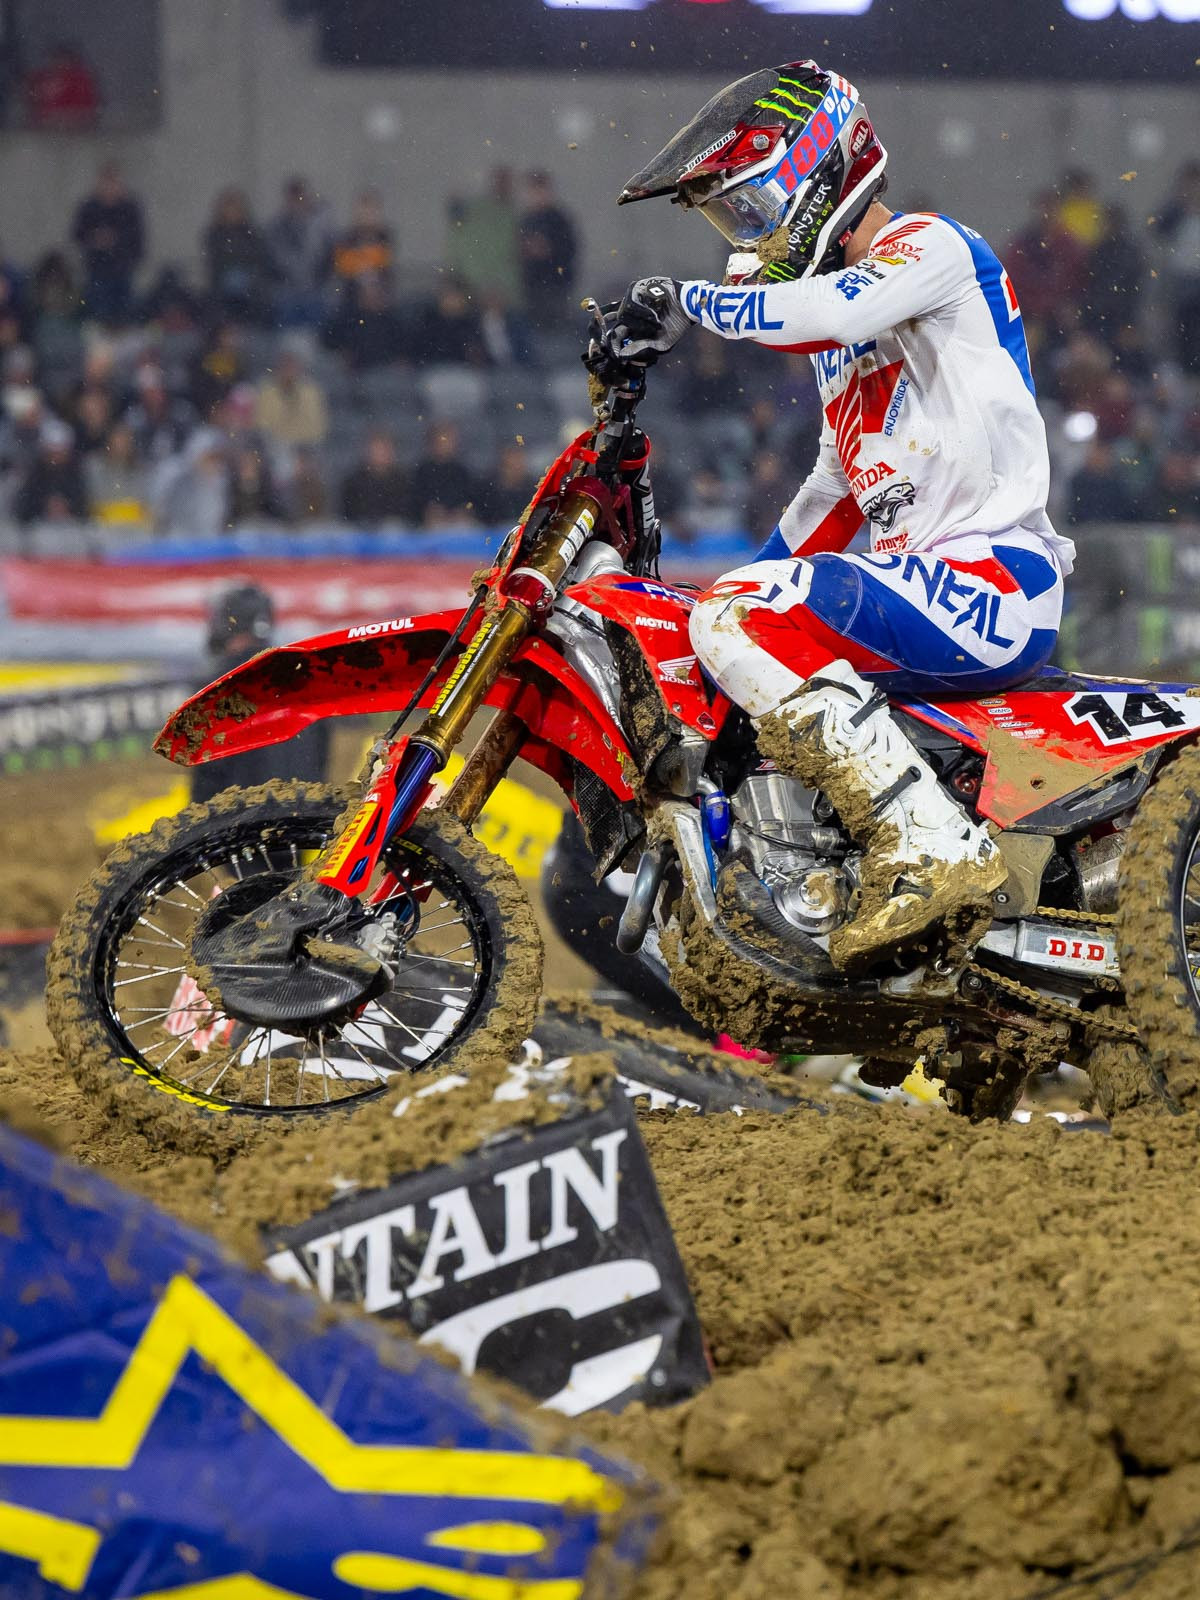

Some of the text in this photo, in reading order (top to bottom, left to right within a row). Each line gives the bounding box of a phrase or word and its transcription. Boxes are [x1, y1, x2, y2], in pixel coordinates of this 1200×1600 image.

[851, 126, 869, 155] BELL
[884, 402, 901, 437] ENJOY
[895, 379, 910, 400] RIDE
[348, 617, 415, 639] MOTUL
[635, 615, 679, 632] MOTUL
[1071, 692, 1187, 740] 14
[1048, 939, 1105, 961] D.I.D
